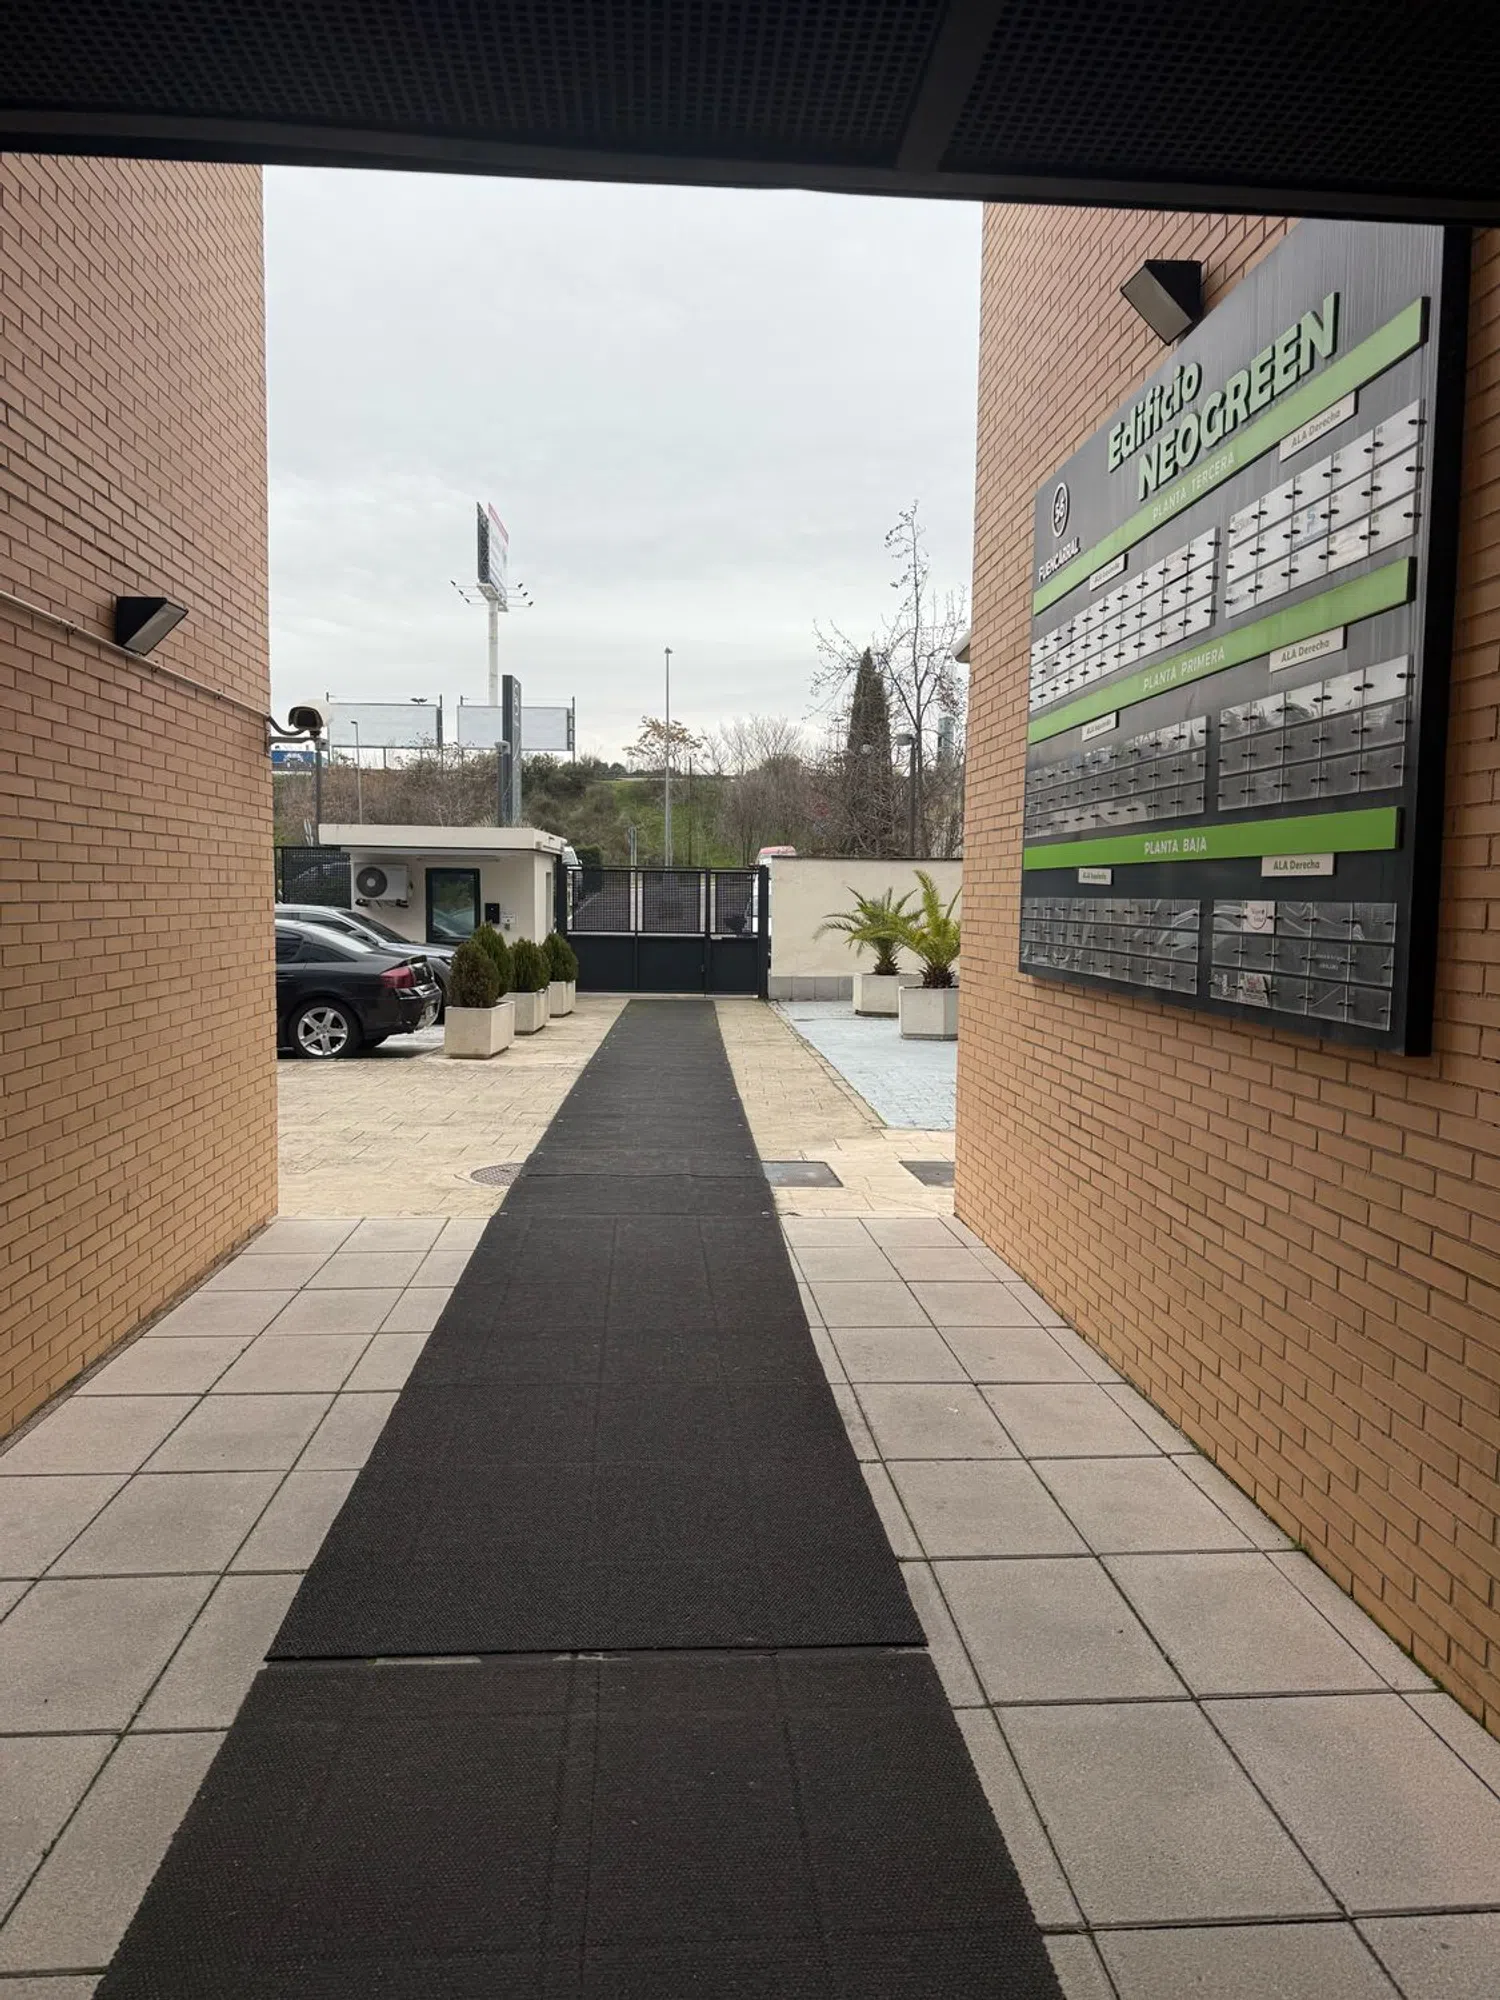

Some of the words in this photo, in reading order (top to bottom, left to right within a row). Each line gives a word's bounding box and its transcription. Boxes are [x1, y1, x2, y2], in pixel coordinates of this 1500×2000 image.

[1108, 362, 1201, 473] Edificio
[1138, 292, 1339, 501] NEOGREEN
[1291, 430, 1307, 448] ALA
[1309, 409, 1341, 436] Derecha
[1153, 487, 1187, 520] PLANTA
[1191, 452, 1235, 492] TERCERA
[1143, 667, 1177, 692] PLANTA
[1181, 646, 1225, 676] PRIMERA
[1281, 651, 1297, 663] ALA
[1298, 639, 1330, 657] Derecha
[1144, 840, 1178, 855] PLANTA
[1183, 836, 1207, 853] BAJA
[1273, 860, 1288, 870] ALA
[1290, 859, 1320, 870] Derecha
